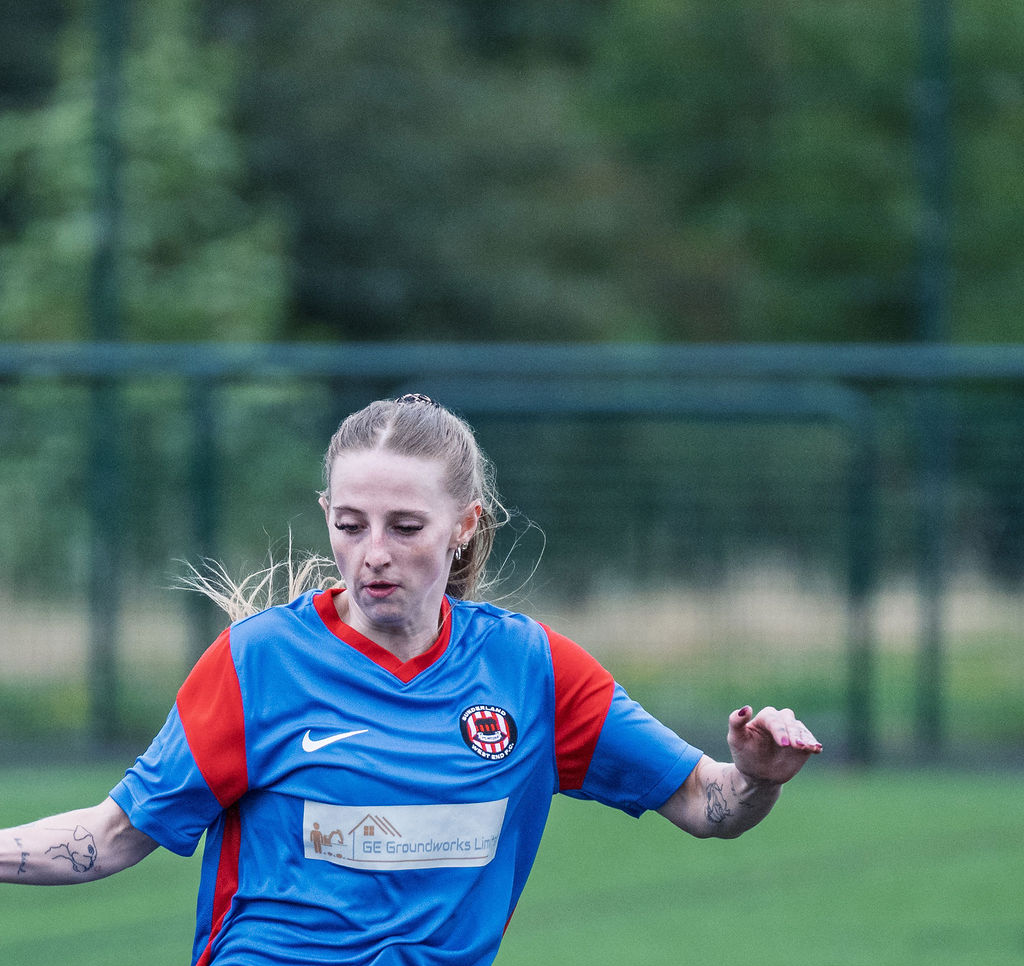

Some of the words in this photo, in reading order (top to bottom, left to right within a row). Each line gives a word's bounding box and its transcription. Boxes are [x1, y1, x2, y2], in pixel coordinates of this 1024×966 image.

[461, 705, 507, 722] SUNDERLAND
[471, 743, 491, 759] WEST
[490, 751, 505, 760] END
[362, 841, 382, 854] GE
[386, 838, 471, 854] Groundworks
